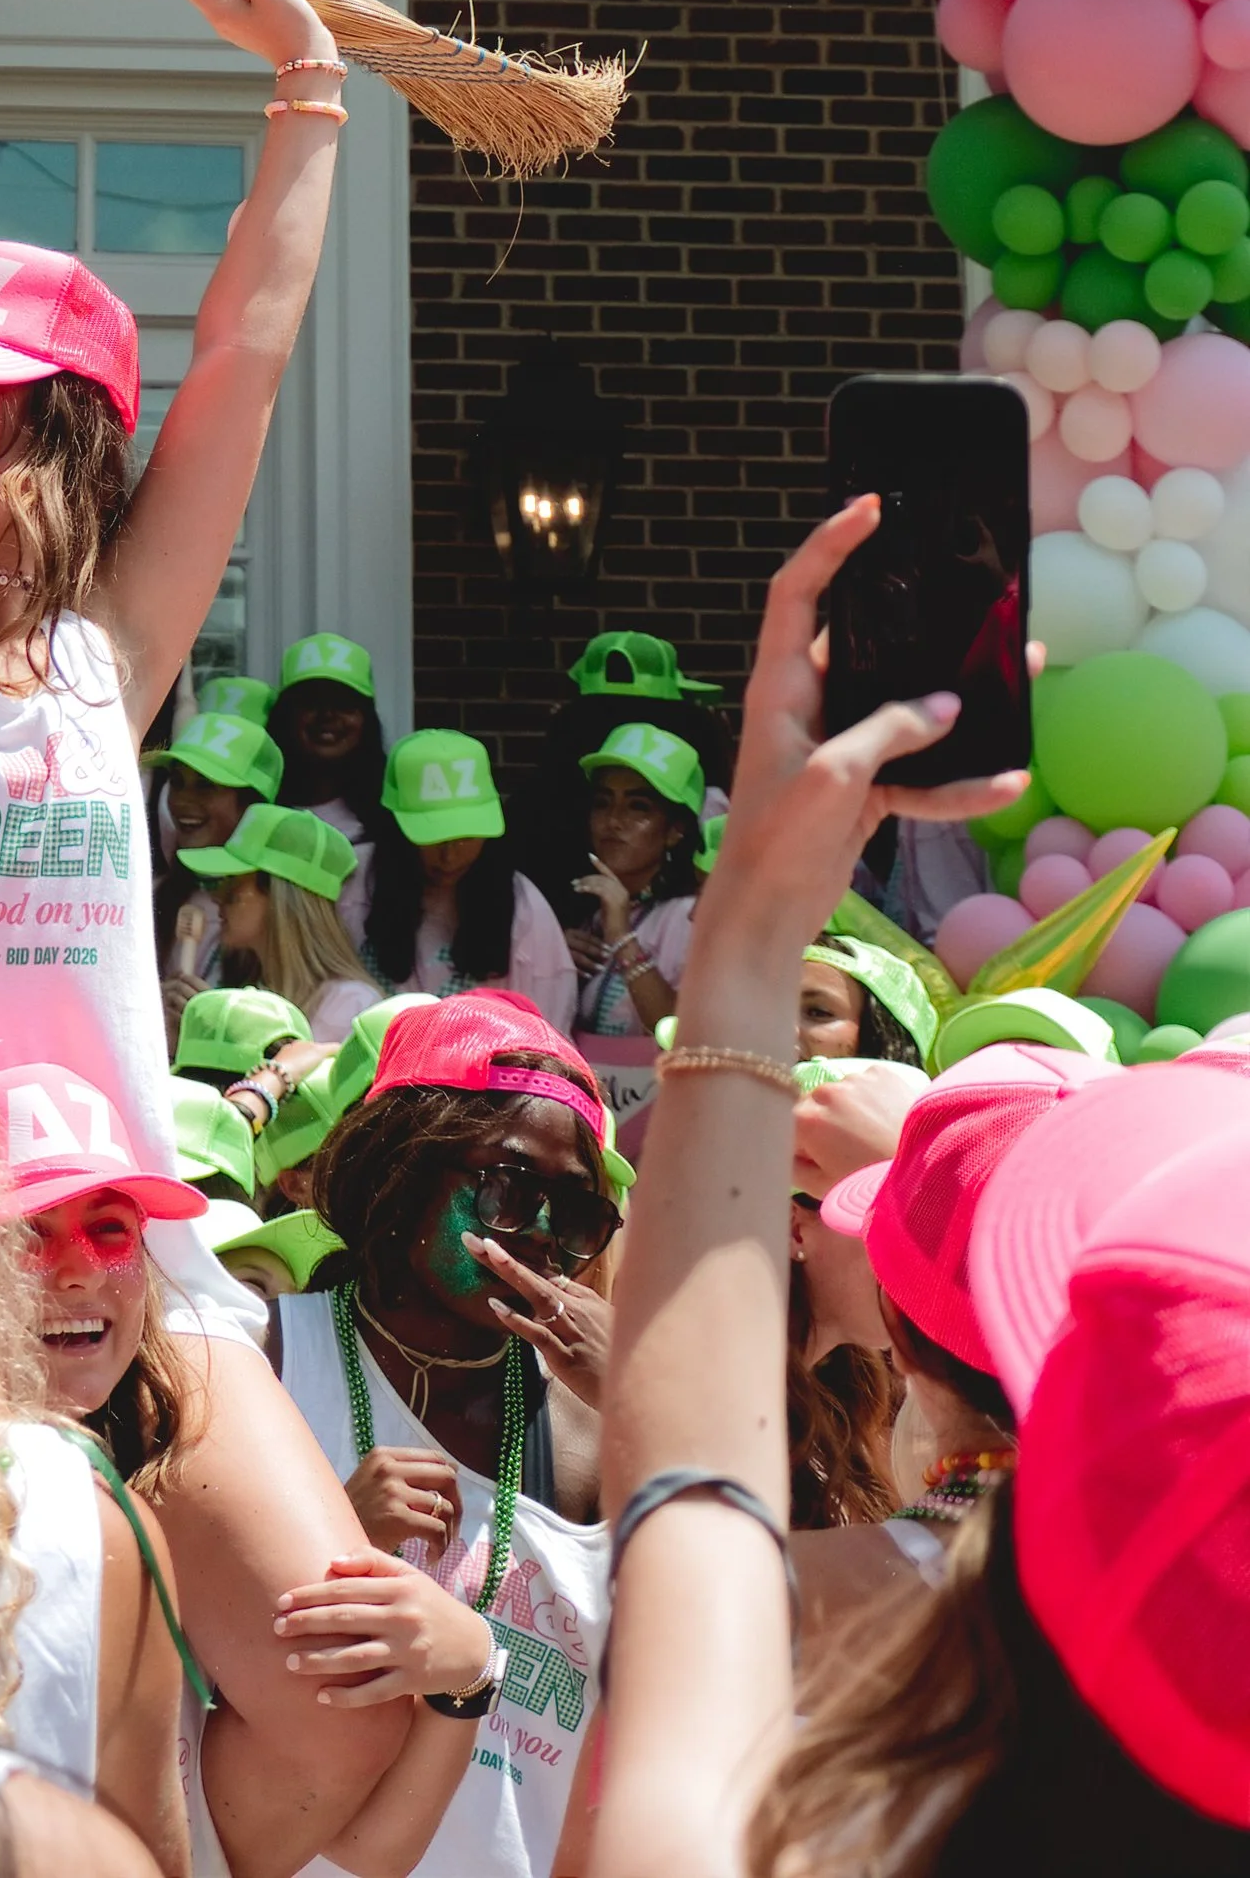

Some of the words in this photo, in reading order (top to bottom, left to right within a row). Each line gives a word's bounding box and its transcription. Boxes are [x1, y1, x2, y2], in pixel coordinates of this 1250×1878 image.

[35, 899, 73, 926] on
[76, 901, 126, 932] you
[5, 946, 30, 966] BID
[33, 946, 60, 965] DAY
[63, 946, 98, 966] 2026
[479, 1749, 504, 1771] DAY
[511, 1728, 563, 1767] you
